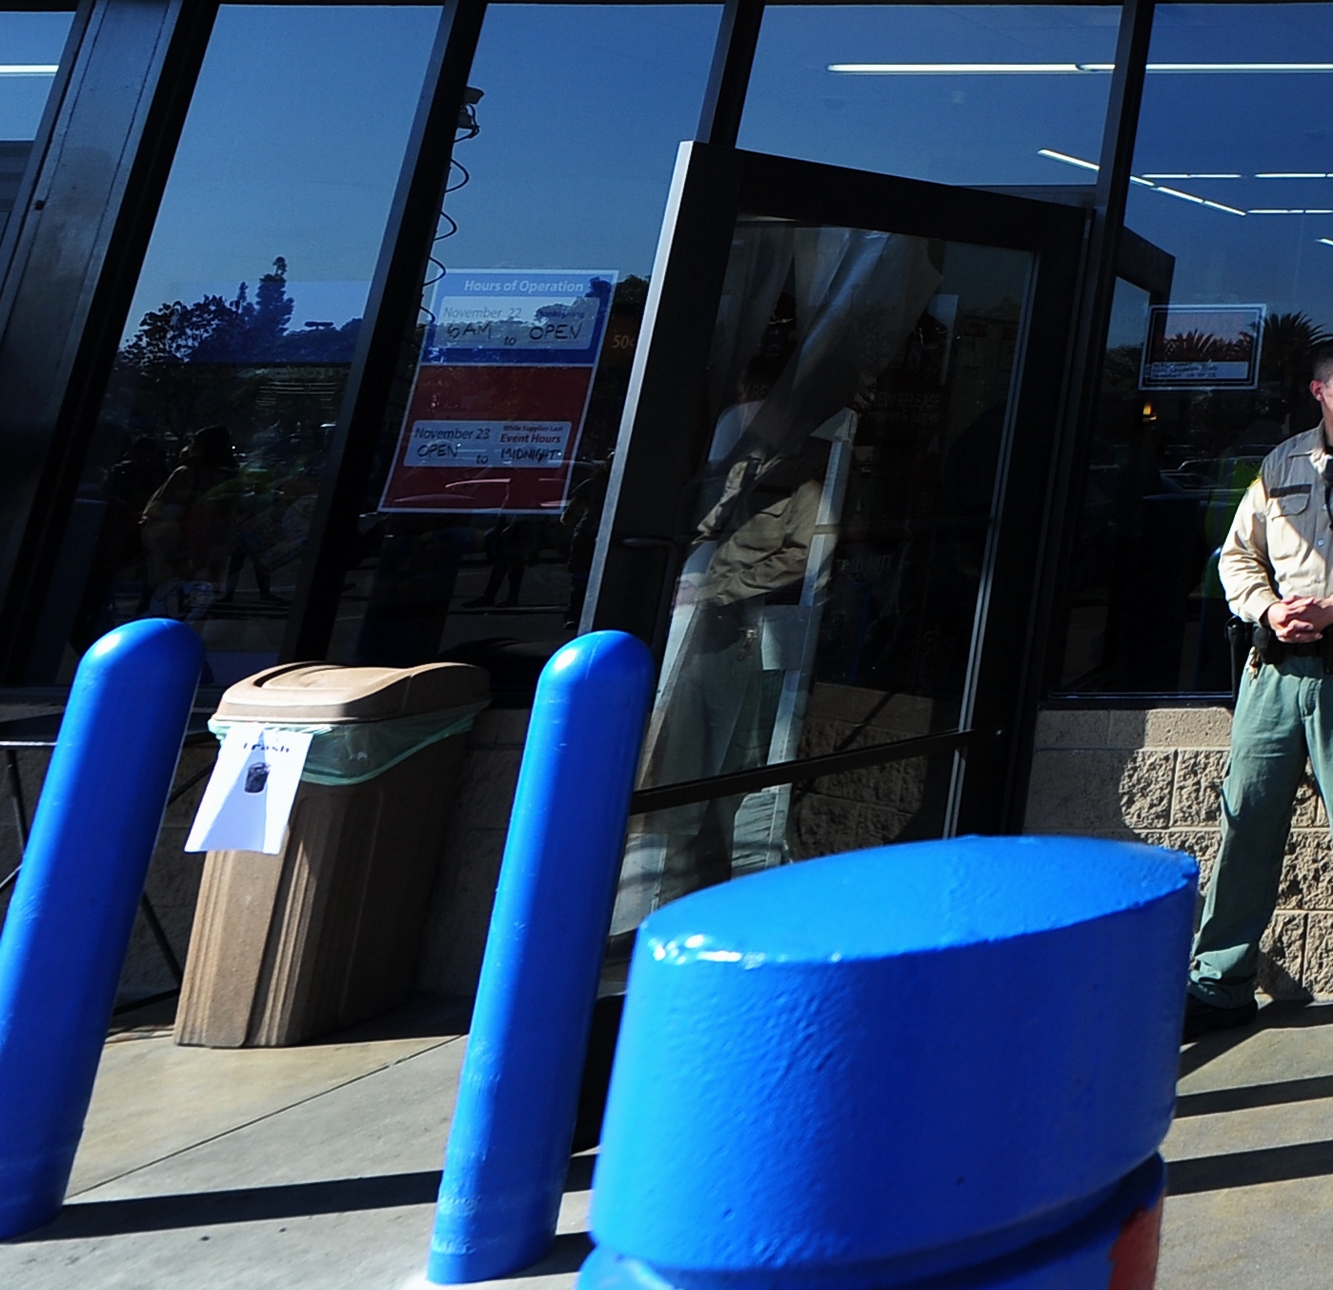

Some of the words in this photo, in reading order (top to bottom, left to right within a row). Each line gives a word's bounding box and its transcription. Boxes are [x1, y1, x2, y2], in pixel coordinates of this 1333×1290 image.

[464, 279, 501, 293] Hours
[503, 279, 517, 292] of
[519, 280, 584, 294] Operation
[442, 307, 502, 319] November
[507, 307, 522, 318] 22
[529, 322, 583, 341] OPEN
[503, 336, 517, 347] to
[414, 427, 473, 440] November
[475, 428, 491, 440] 23
[500, 433, 529, 443] Event
[530, 434, 561, 444] Hours
[417, 443, 459, 458] OPEN
[501, 447, 557, 461] MIDNIGHT
[476, 454, 489, 465] to
